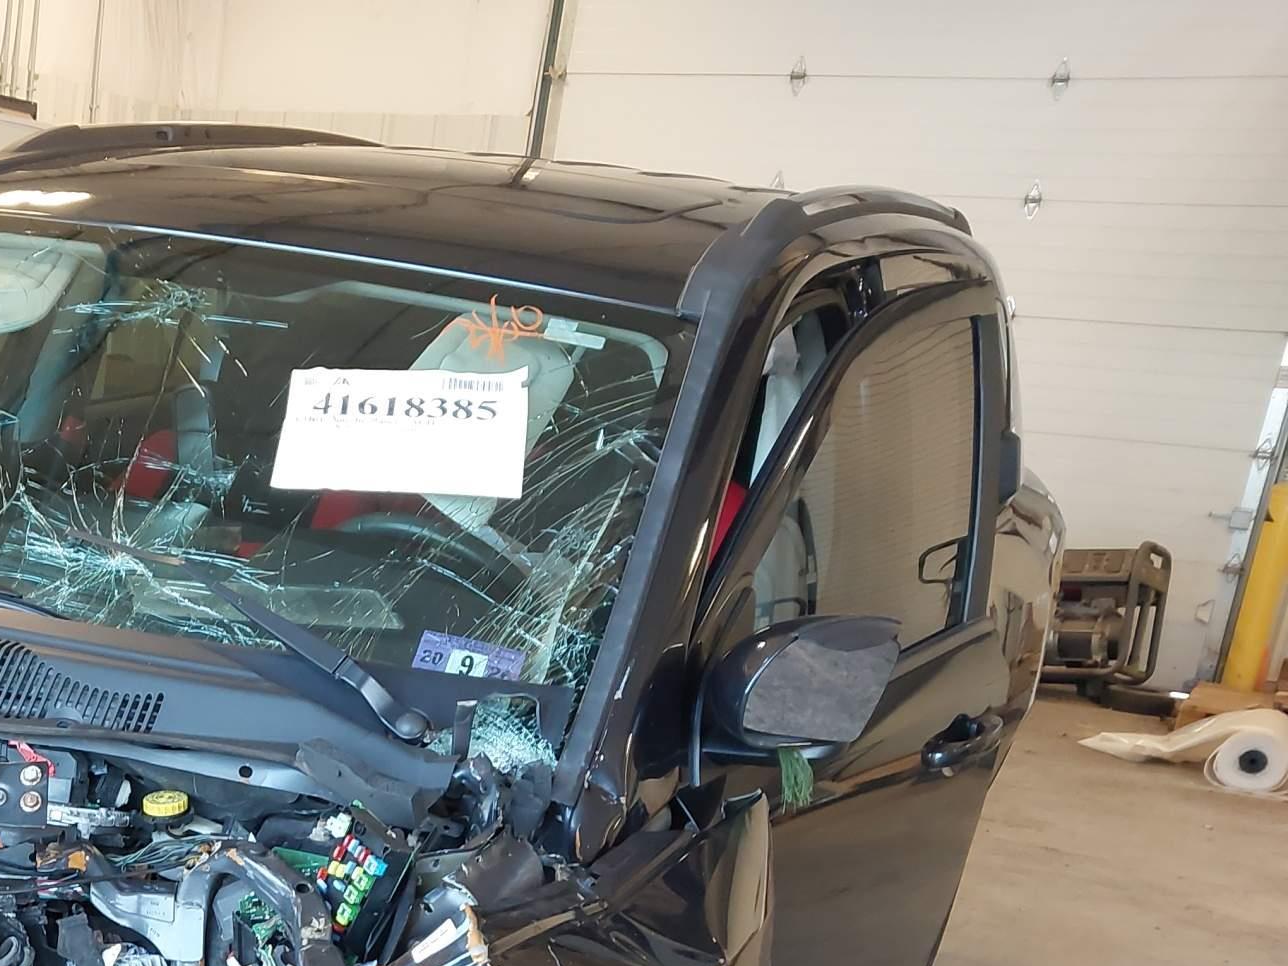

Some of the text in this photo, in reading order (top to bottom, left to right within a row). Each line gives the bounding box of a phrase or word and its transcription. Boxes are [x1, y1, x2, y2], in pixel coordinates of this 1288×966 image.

[313, 392, 499, 421] 41618385
[420, 649, 444, 666] 20
[460, 655, 475, 676] 9
